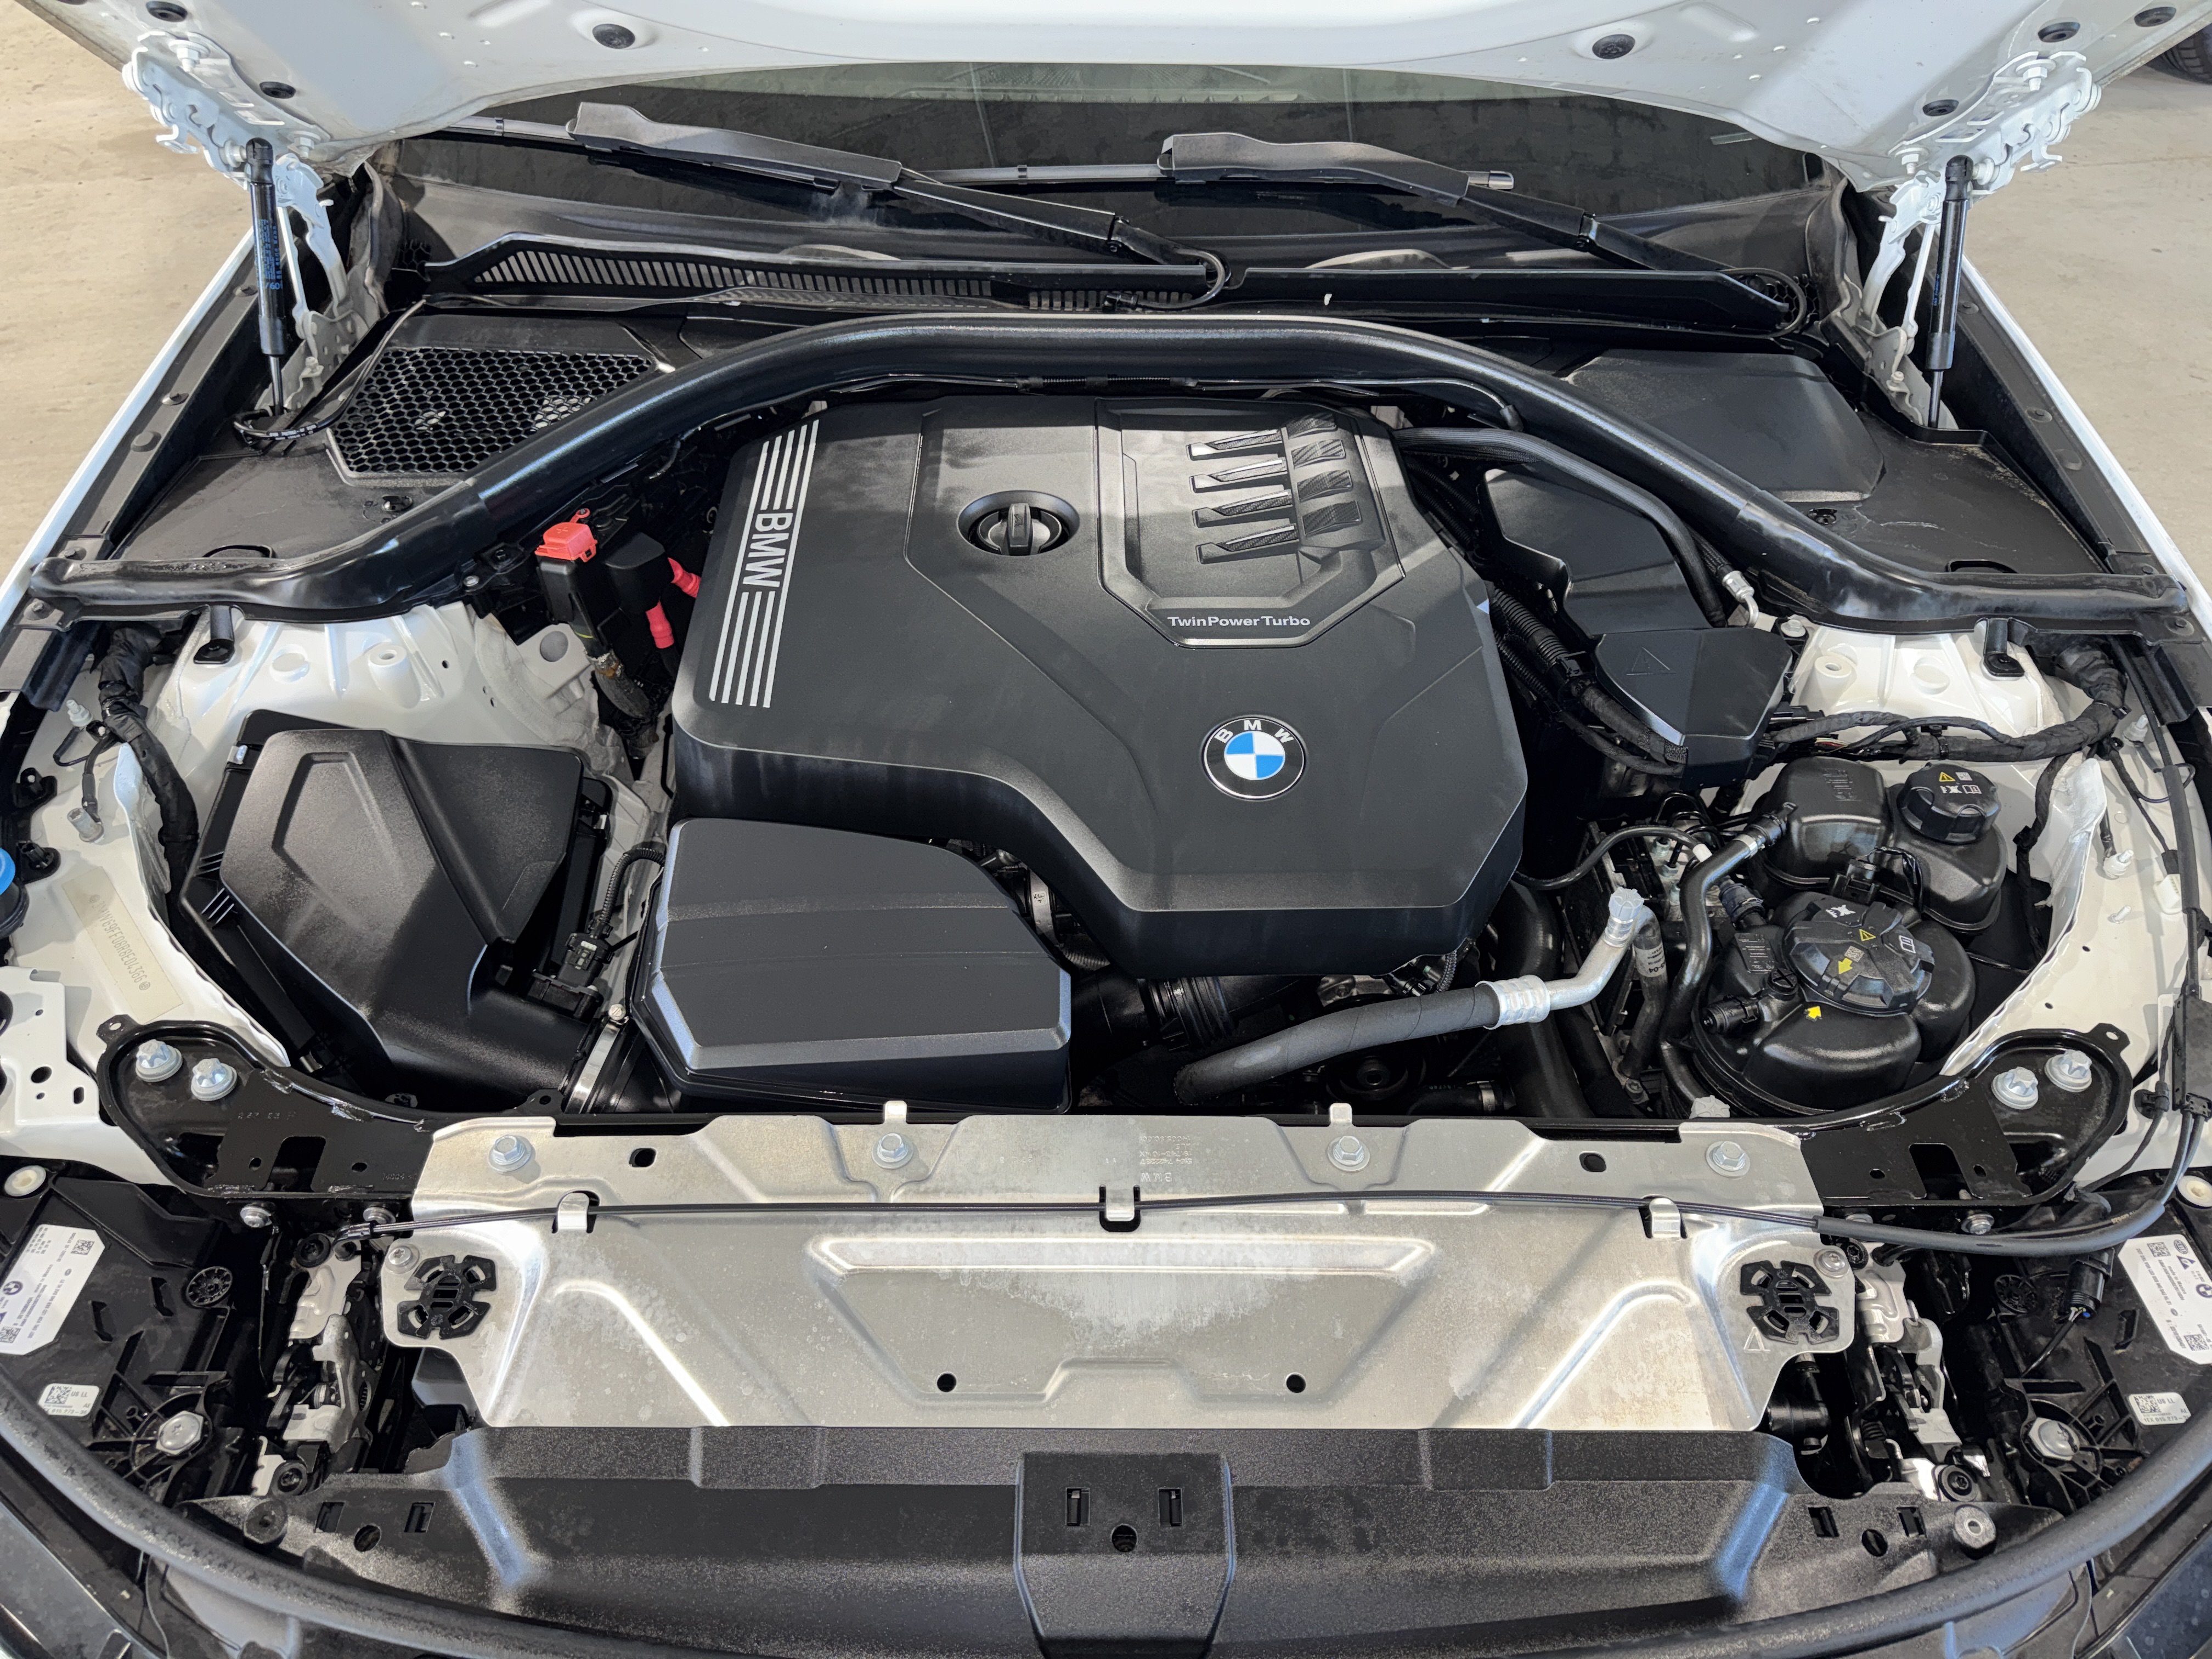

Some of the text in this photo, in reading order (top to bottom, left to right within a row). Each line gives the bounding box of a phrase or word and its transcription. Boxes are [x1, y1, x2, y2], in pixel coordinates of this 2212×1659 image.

[742, 512, 793, 588] BMW
[1261, 616, 1311, 626] Turbo
[1214, 720, 1294, 743] BMW
[1141, 1172, 1172, 1182] BMW
